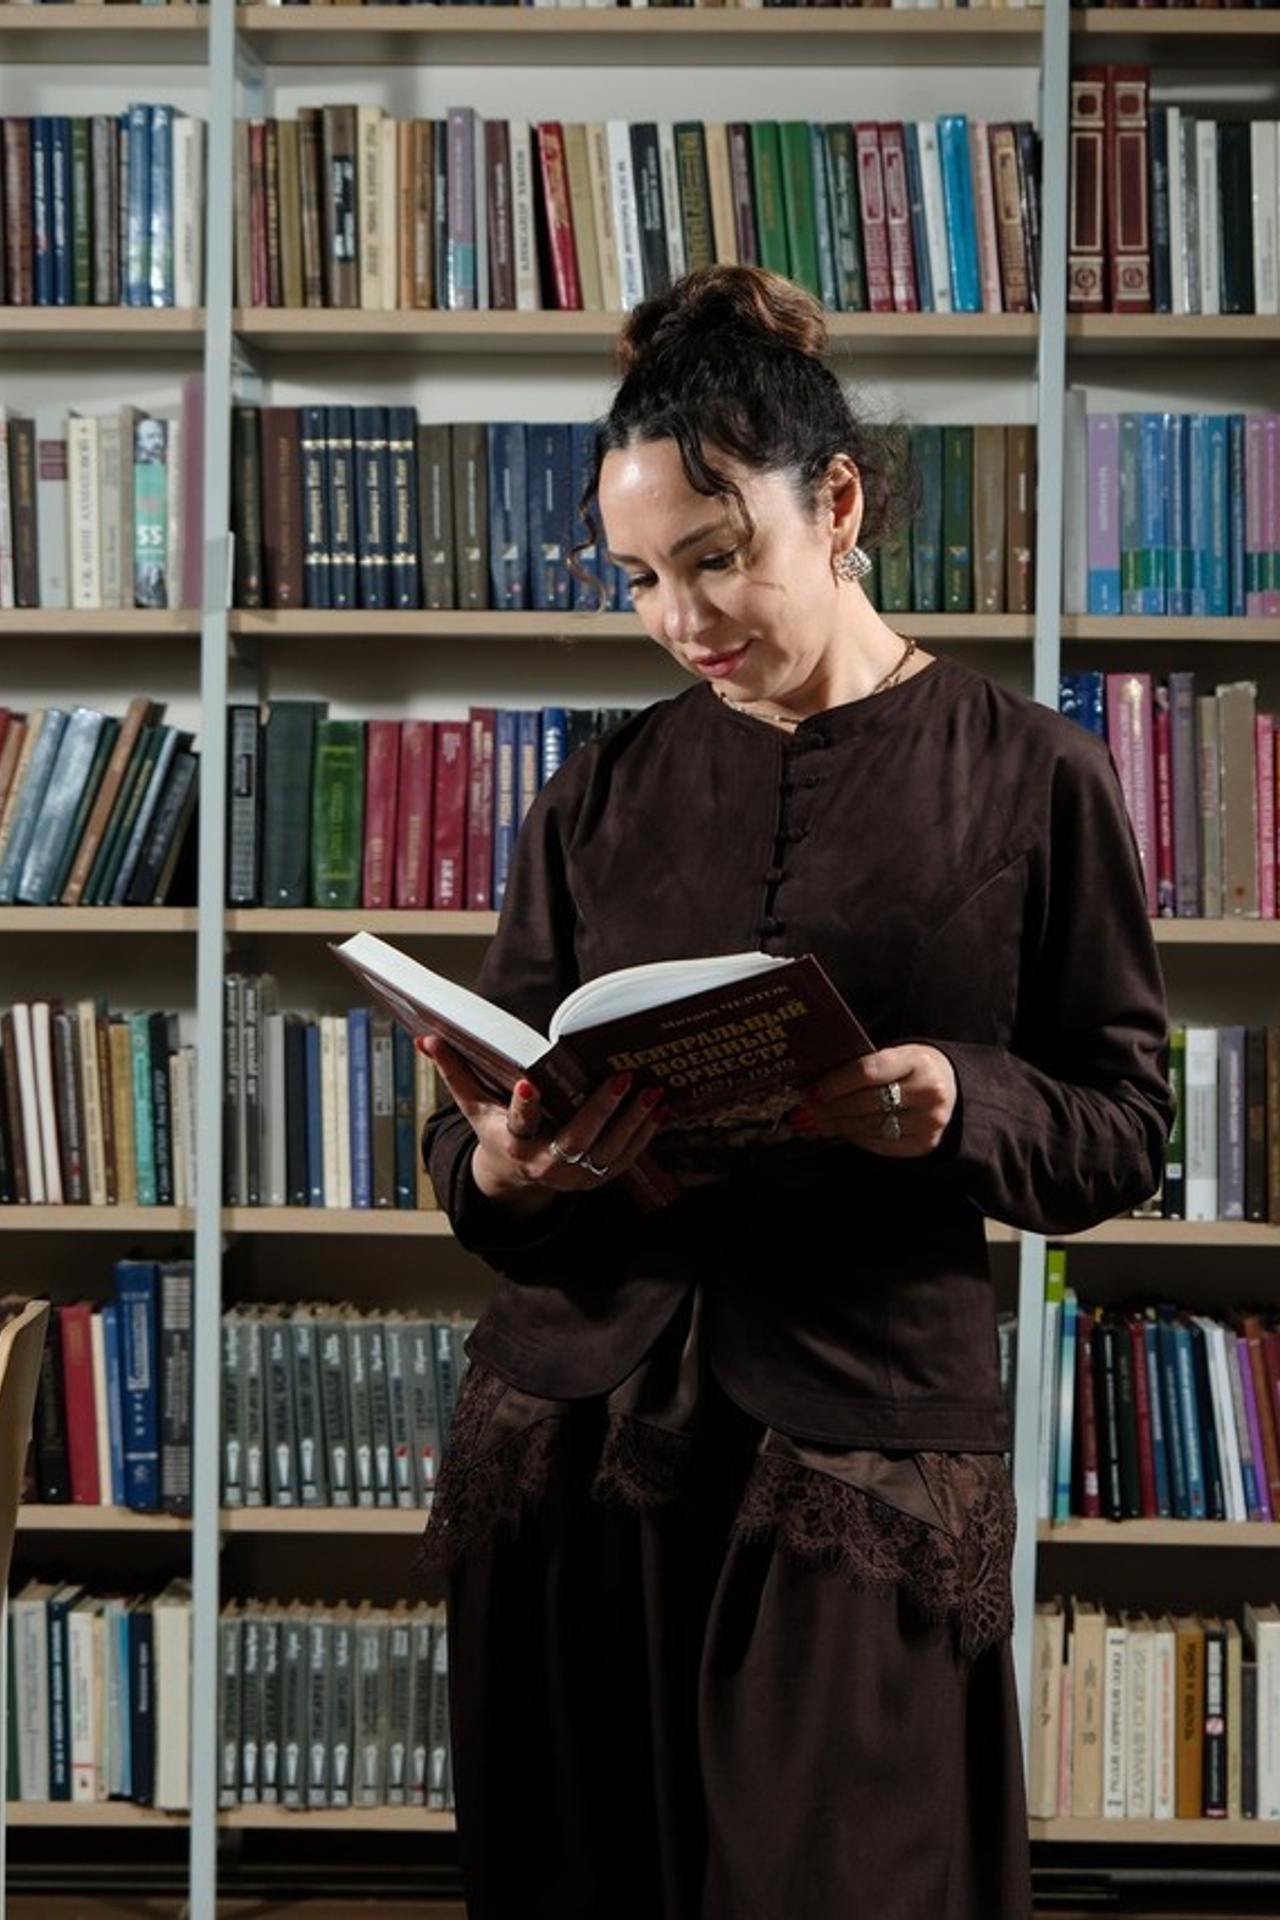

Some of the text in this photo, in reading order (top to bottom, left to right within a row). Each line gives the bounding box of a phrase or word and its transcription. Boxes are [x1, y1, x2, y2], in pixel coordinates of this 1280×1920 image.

[608, 999, 809, 1072] ЦЕНТРАЛЬНЫЙ
[650, 1027, 787, 1077] ВОЕННЫЙ
[669, 1042, 789, 1088] ОРКЕСТР
